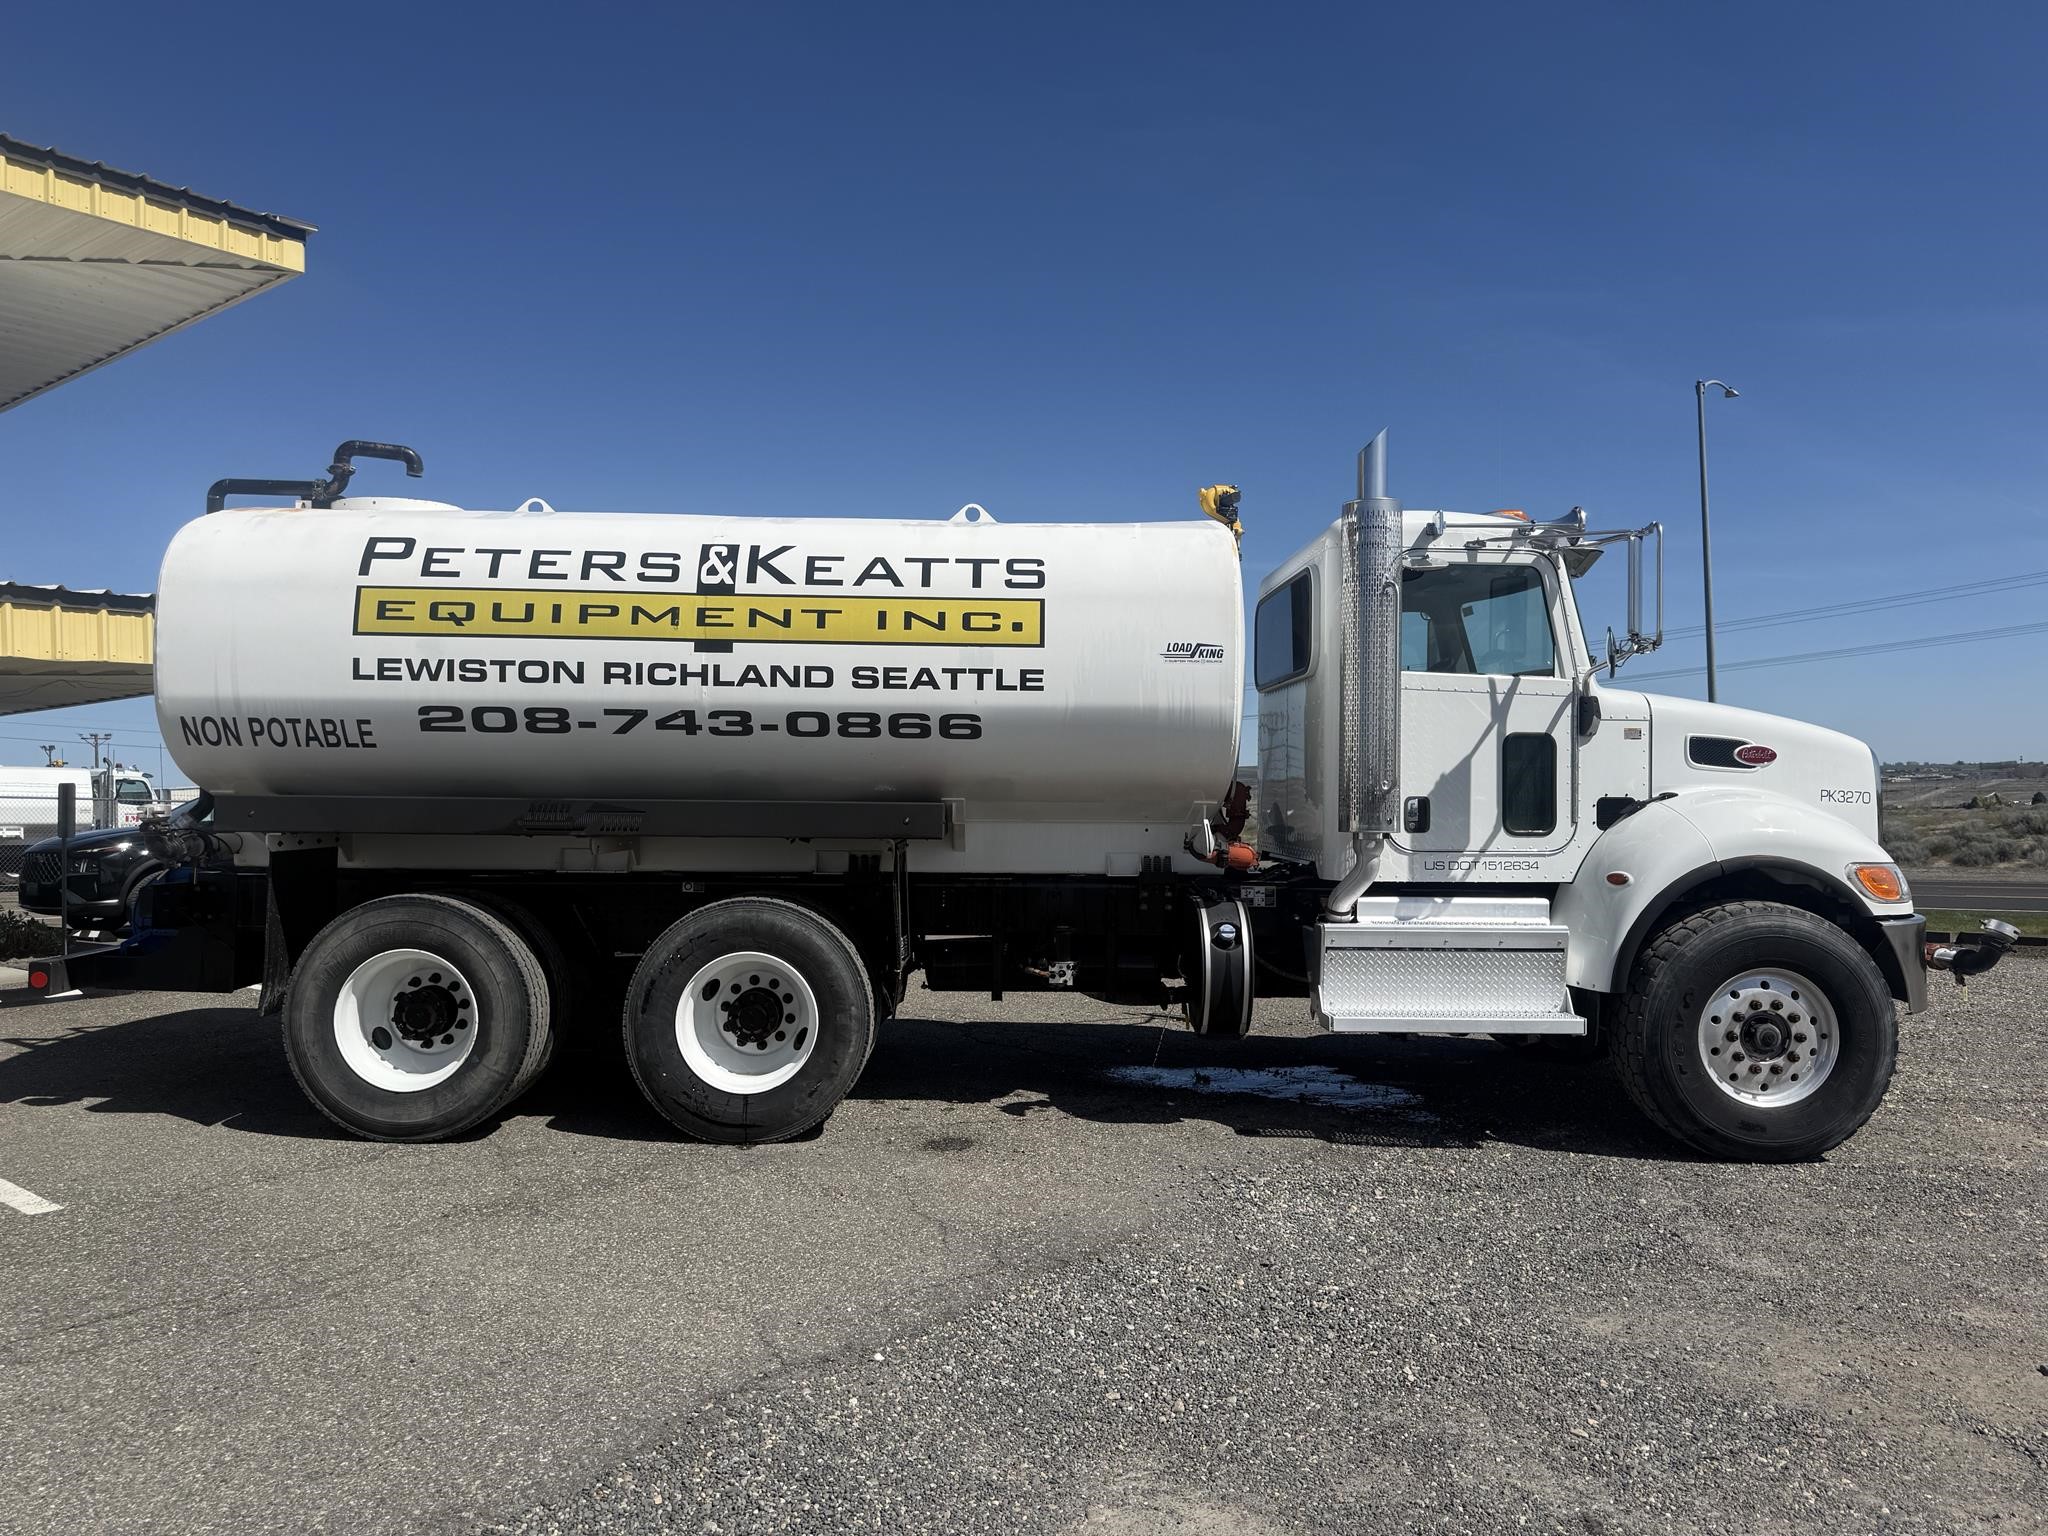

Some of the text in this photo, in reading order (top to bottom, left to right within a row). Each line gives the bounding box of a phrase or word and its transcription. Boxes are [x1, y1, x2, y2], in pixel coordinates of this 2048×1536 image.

[358, 537, 1045, 590] PETERS & KEATTS
[376, 600, 1023, 632] EQUIPMENT INC.
[1166, 642, 1224, 659] LOAD KING
[353, 657, 1045, 691] LEWISTON RICHLAND SEATTLE
[180, 716, 377, 748] NON POTABLE
[418, 705, 982, 740] 208-743-0866
[1820, 789, 1871, 804] PK3270
[1424, 860, 1539, 871] US DOT 1512634
